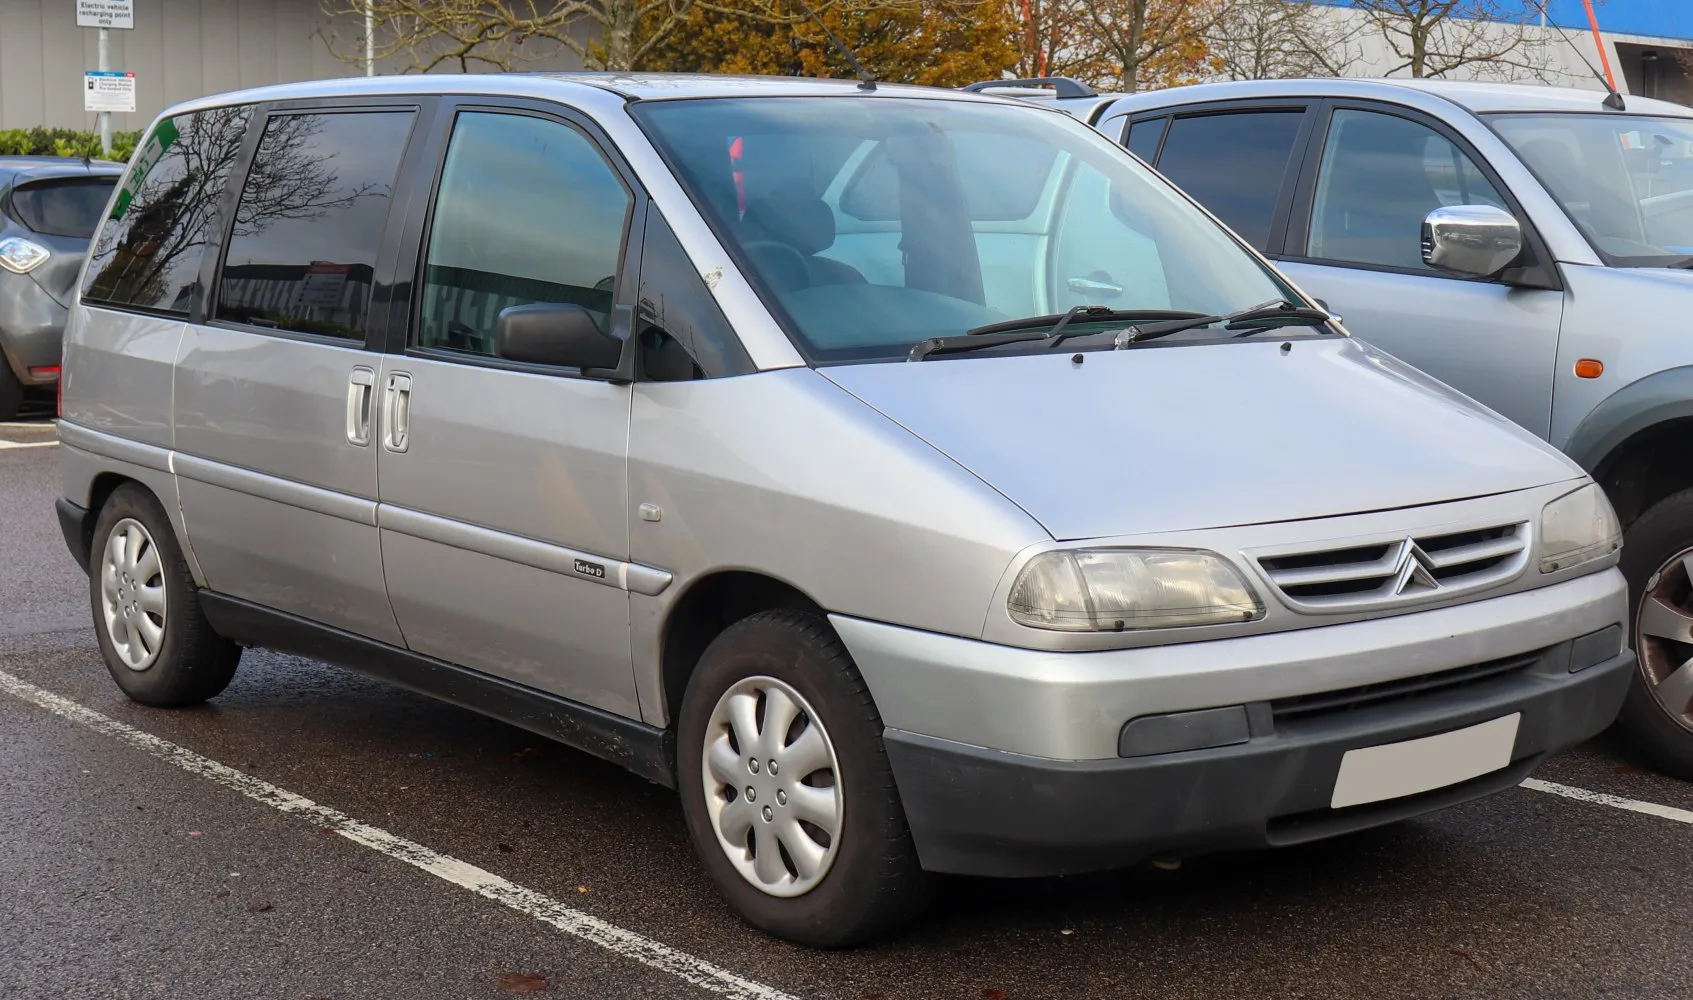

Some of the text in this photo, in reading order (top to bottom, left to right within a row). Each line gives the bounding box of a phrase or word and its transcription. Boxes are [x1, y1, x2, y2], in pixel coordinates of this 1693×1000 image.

[79, 10, 113, 18] recharging
[575, 561, 602, 577] Turbo D
